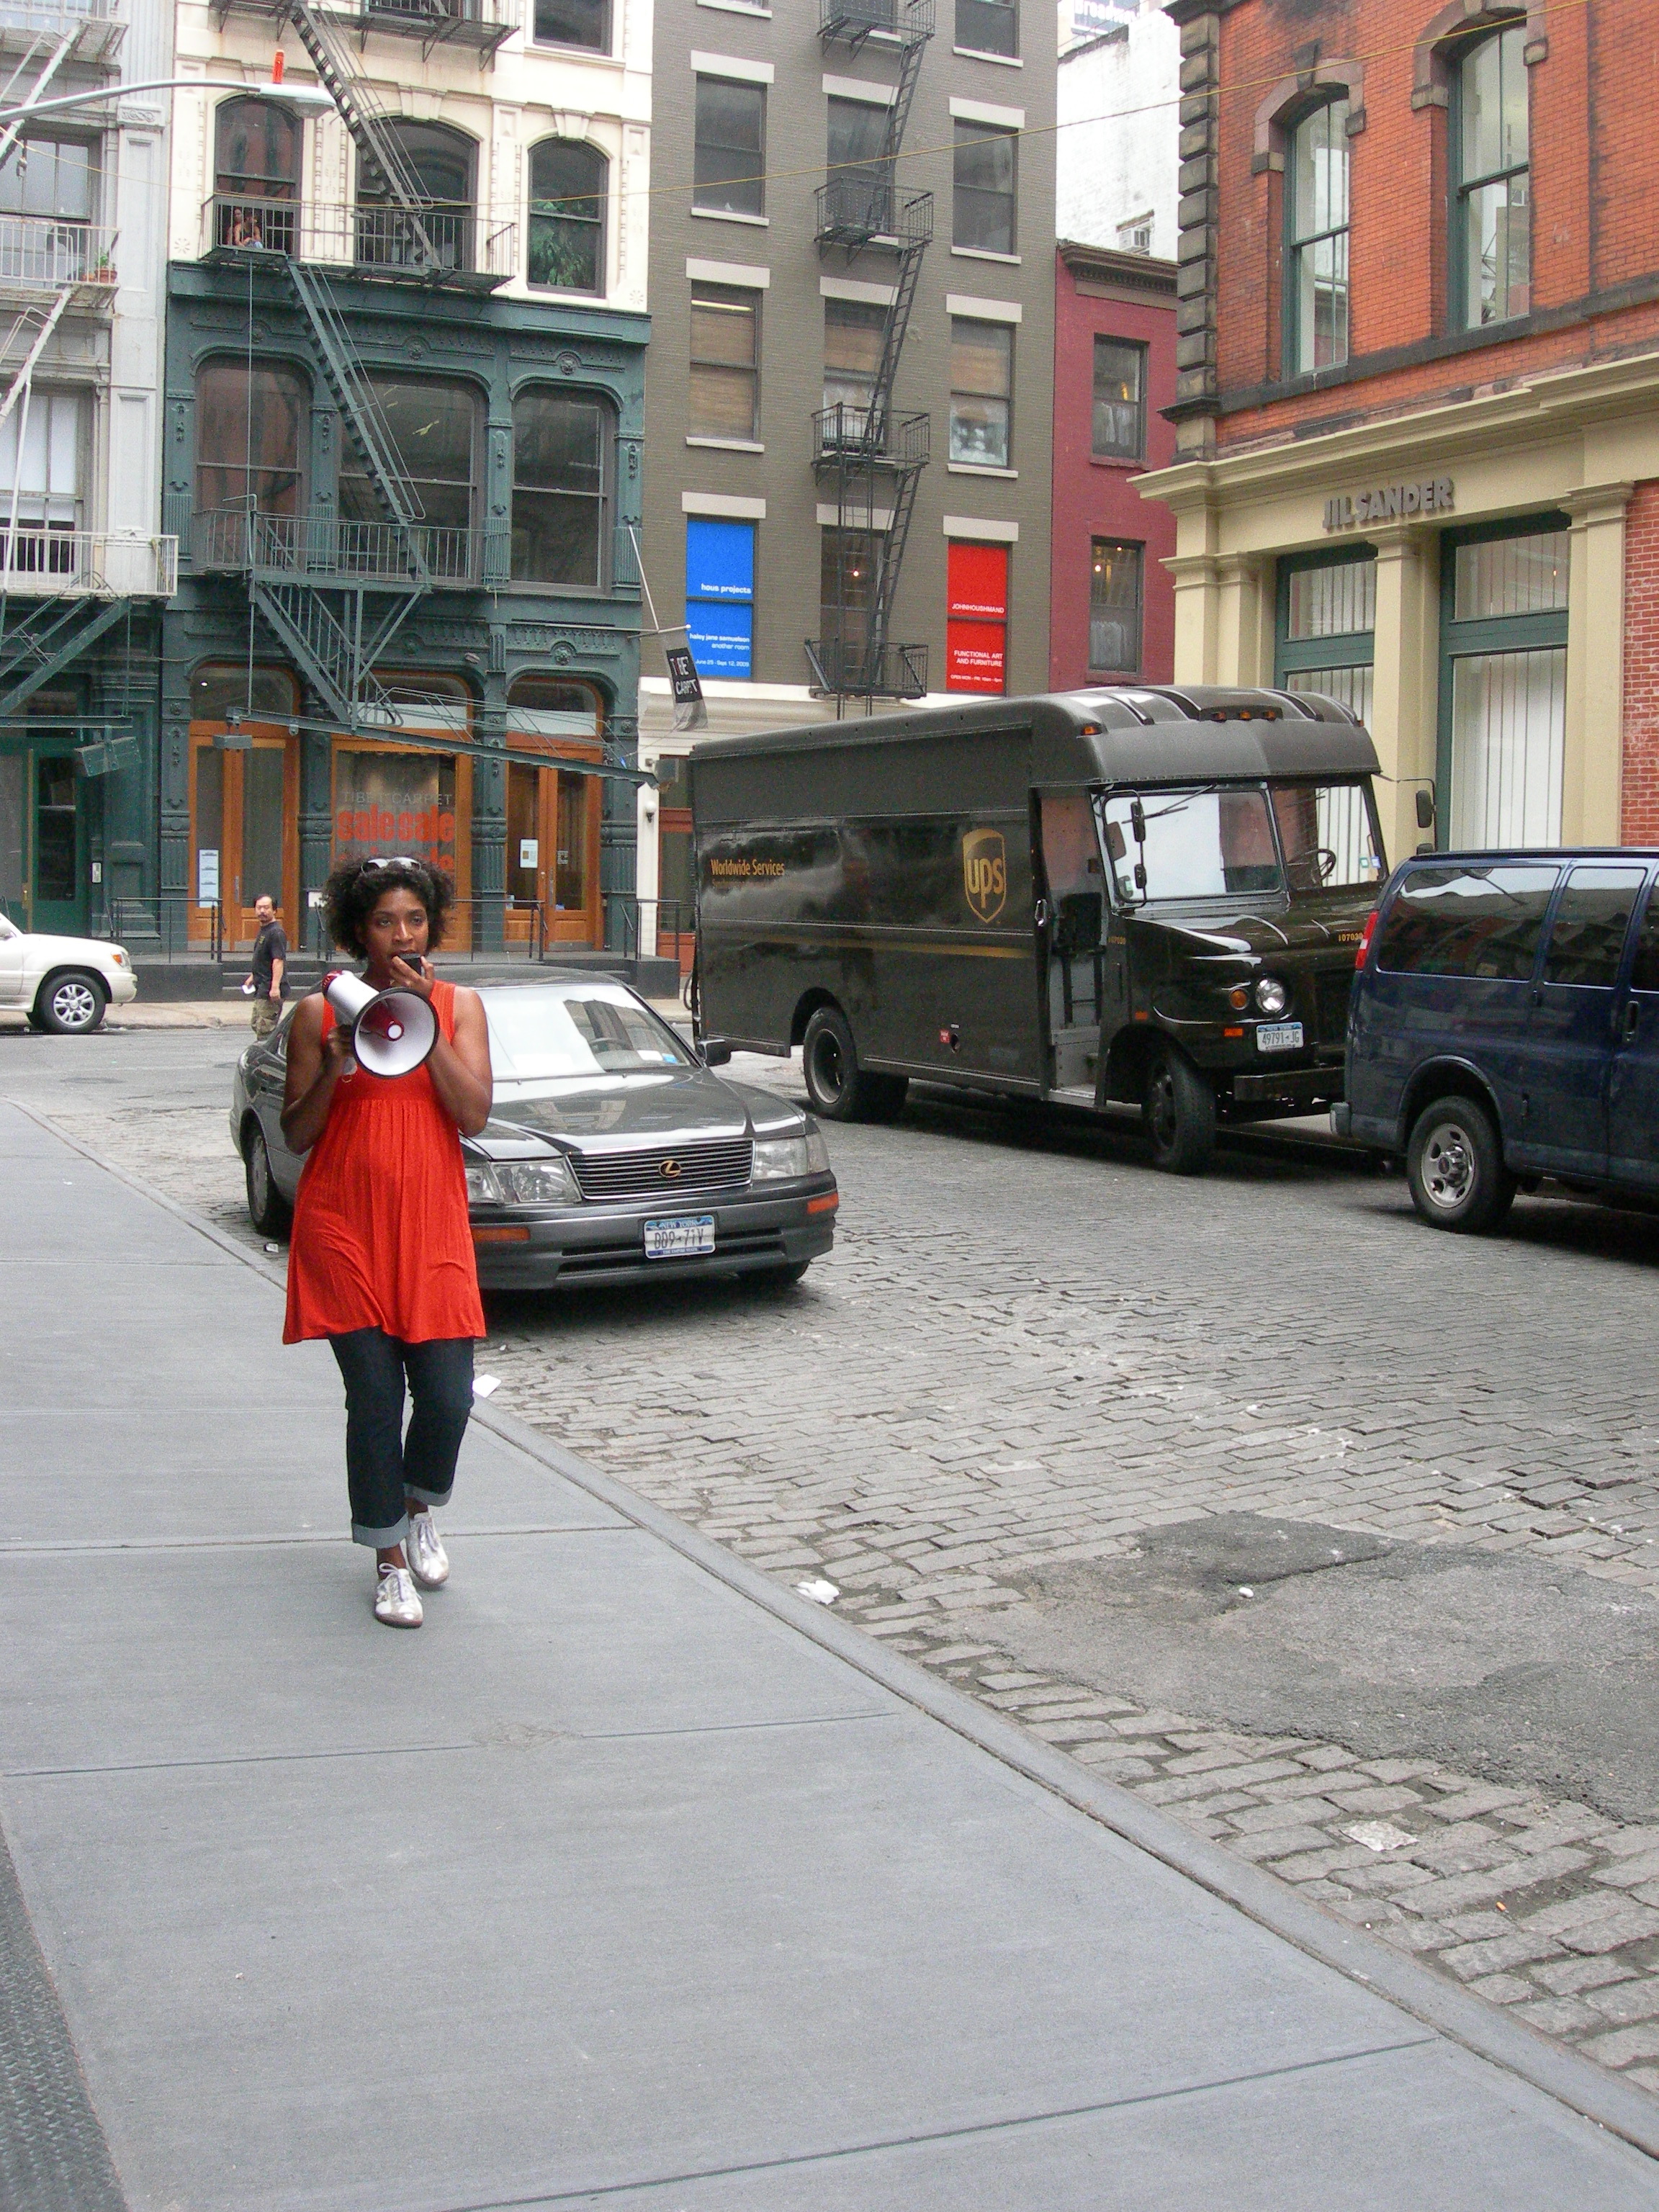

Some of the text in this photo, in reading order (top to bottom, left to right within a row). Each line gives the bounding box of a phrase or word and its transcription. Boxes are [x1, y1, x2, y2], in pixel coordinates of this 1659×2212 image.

[1322, 478, 1455, 530] JIL SANDER
[701, 583, 751, 594] hous projects
[954, 649, 990, 659] FUNCTIONAL
[970, 658, 1003, 667] FURNITURE
[392, 792, 452, 805] CARPET
[337, 804, 455, 842] sale sale
[710, 858, 785, 876] Worldwide Services
[967, 858, 1004, 909] ups
